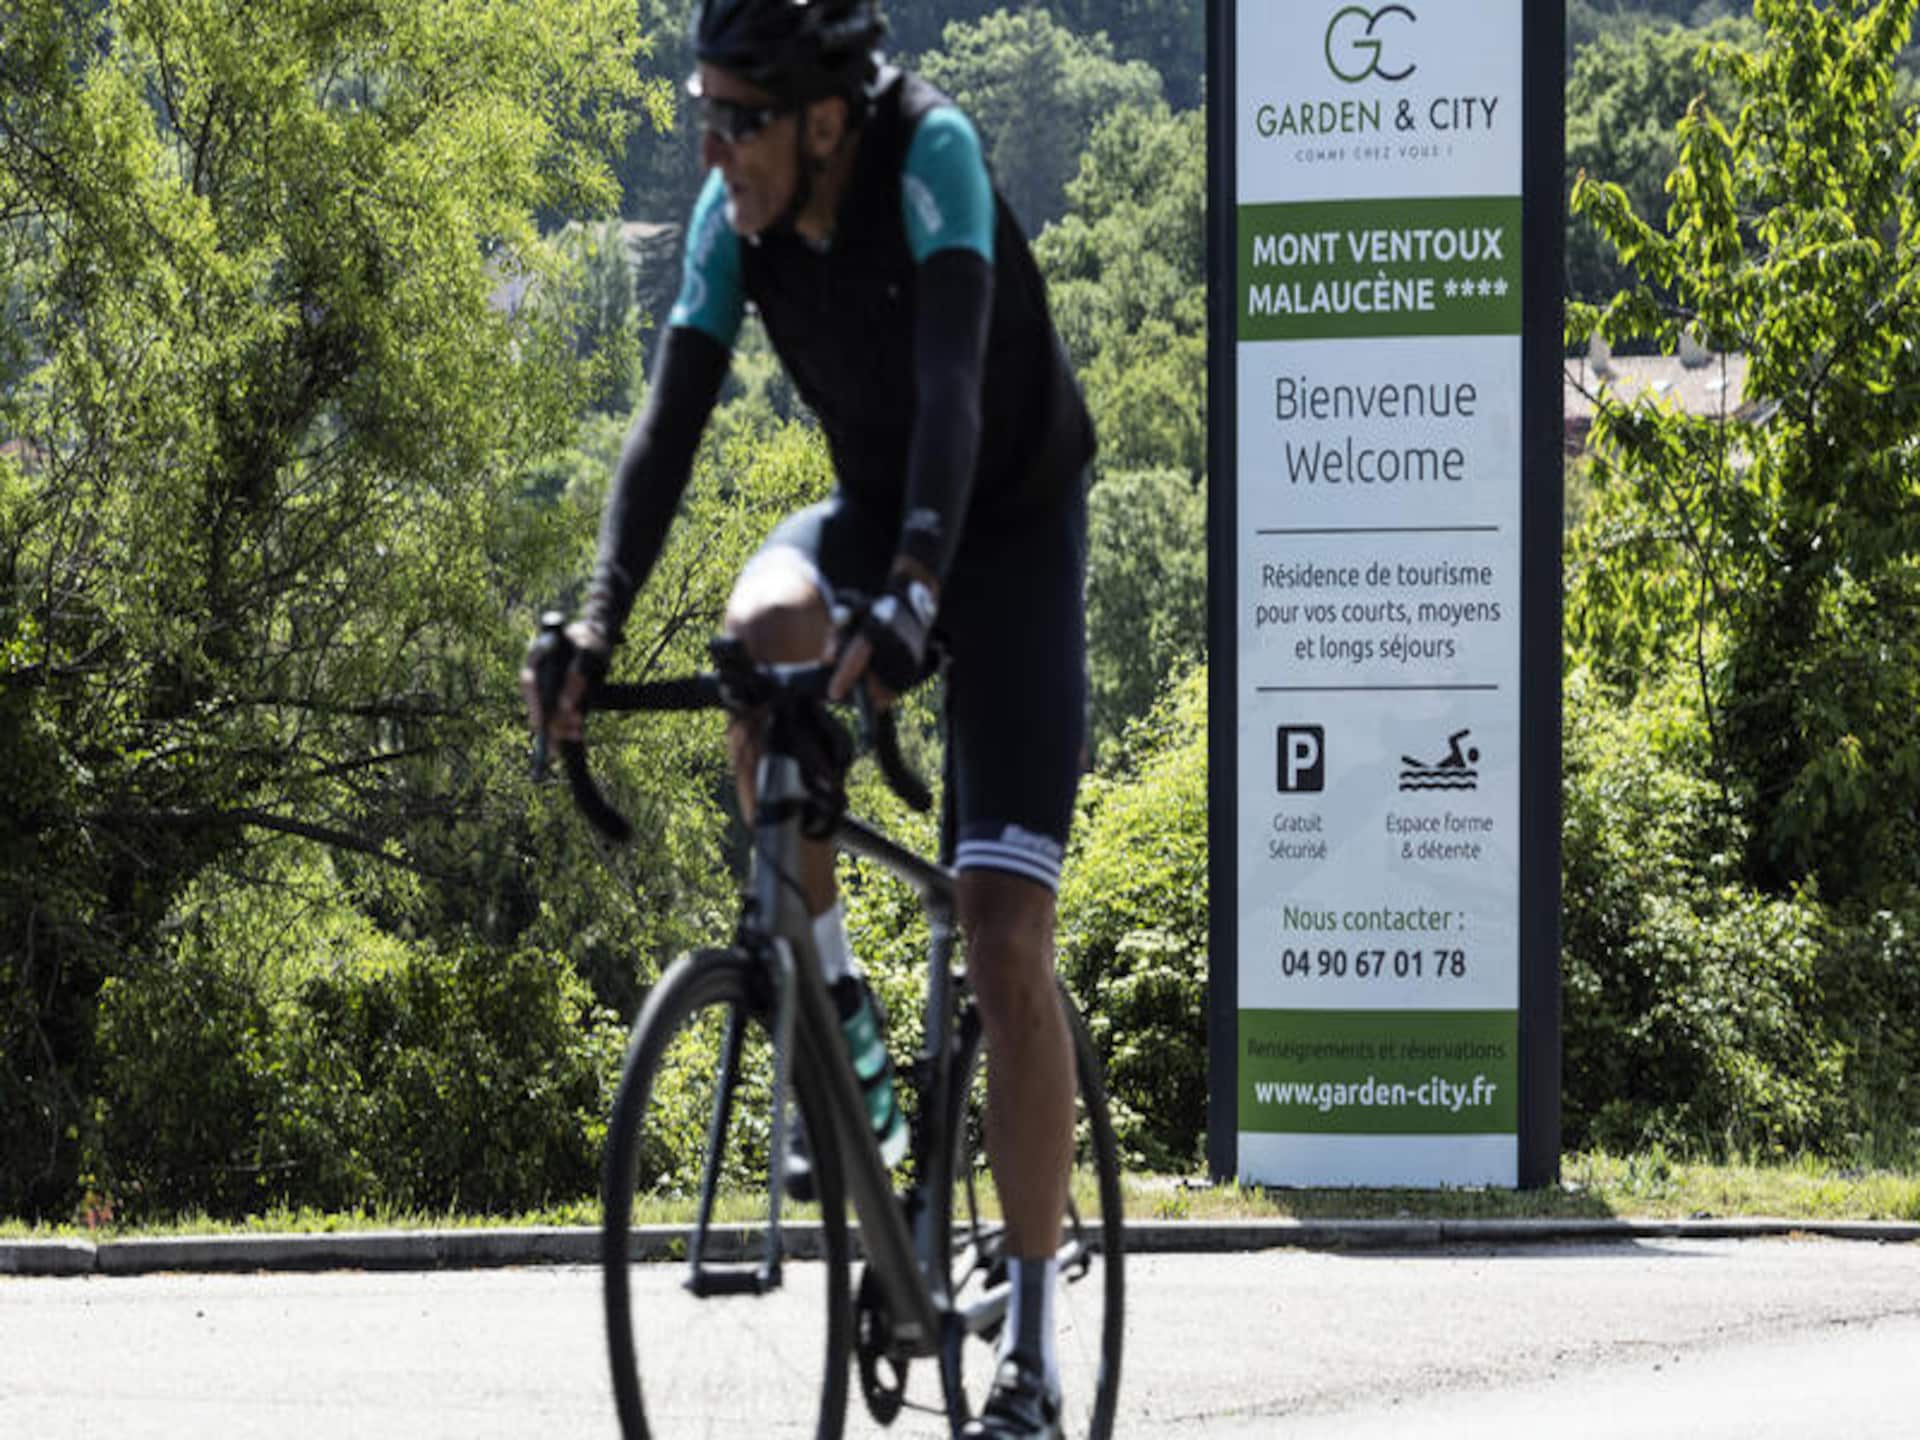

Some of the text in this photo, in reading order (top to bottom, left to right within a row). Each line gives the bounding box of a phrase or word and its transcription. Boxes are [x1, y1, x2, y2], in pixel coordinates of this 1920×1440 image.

[1256, 97, 1498, 138] GARDEN & CITY
[1295, 150, 1345, 163] COMME
[1354, 148, 1390, 160] CHEZ
[1400, 146, 1439, 158] VOUS
[1253, 228, 1502, 267] MONT VENTOUX
[1248, 270, 1435, 316] MALAUCÈNE
[1275, 376, 1477, 420] Bienvenue
[1285, 436, 1464, 484] Welcome
[1262, 561, 1493, 588] Résidence de tourisme
[1256, 601, 1500, 628] pour vos courts, moyens
[1295, 633, 1455, 663] et longs séjours
[1273, 813, 1323, 832] Gratuit
[1386, 812, 1493, 835] Espace forme
[1269, 839, 1327, 859] Sécurisé
[1401, 840, 1481, 859] & détente
[1283, 906, 1337, 931] Nous
[1343, 907, 1452, 931] contacter
[1282, 949, 1466, 977] 04 90 67 01 78
[1248, 1038, 1505, 1063] Renseignements et réservations
[1255, 1074, 1497, 1112] www.garden-city.fr
